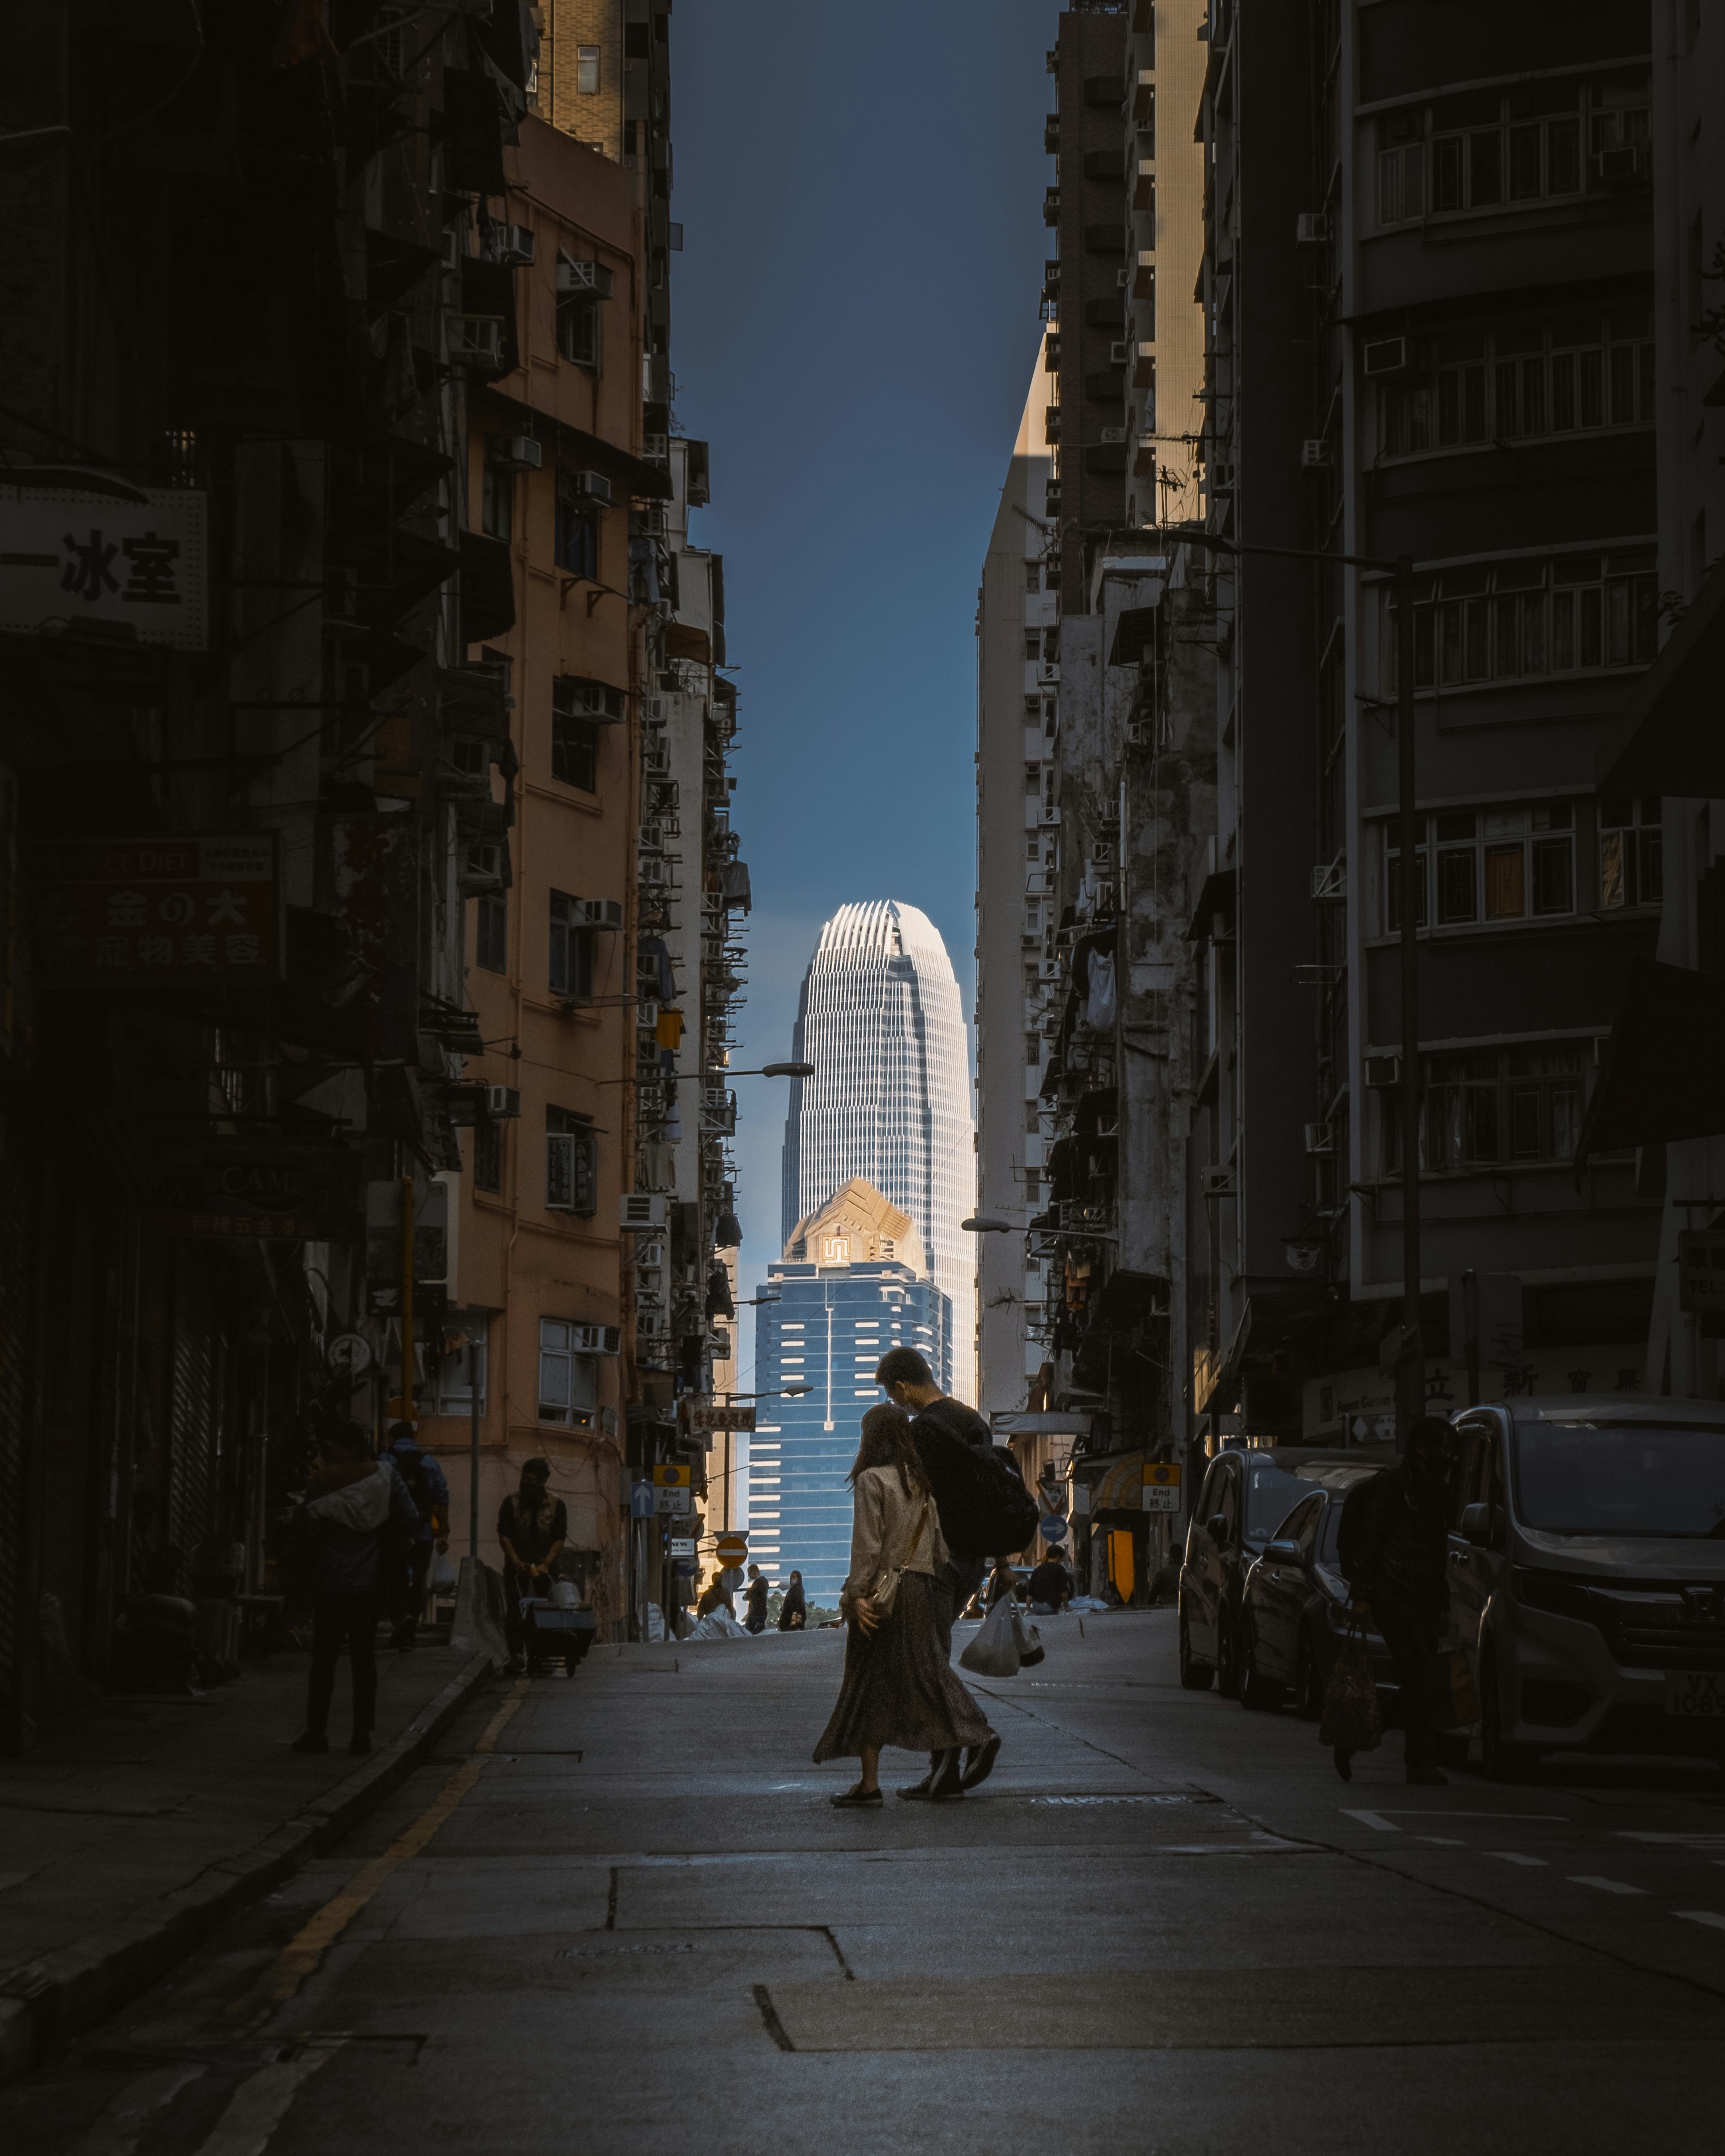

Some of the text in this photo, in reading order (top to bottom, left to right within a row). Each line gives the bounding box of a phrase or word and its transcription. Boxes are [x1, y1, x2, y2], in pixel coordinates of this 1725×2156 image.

[139, 850, 189, 872] DIET
[96, 933, 260, 967] 寵物美容
[1688, 1280, 1724, 1293] TEL:
[1361, 1396, 1390, 1408] Curtain
[663, 1489, 680, 1498] End
[1153, 1488, 1170, 1496] End
[659, 1500, 683, 1510] 終止
[1149, 1498, 1173, 1508] 終止
[1687, 1674, 1718, 1695] VX
[1674, 1694, 1725, 1715] 1089
